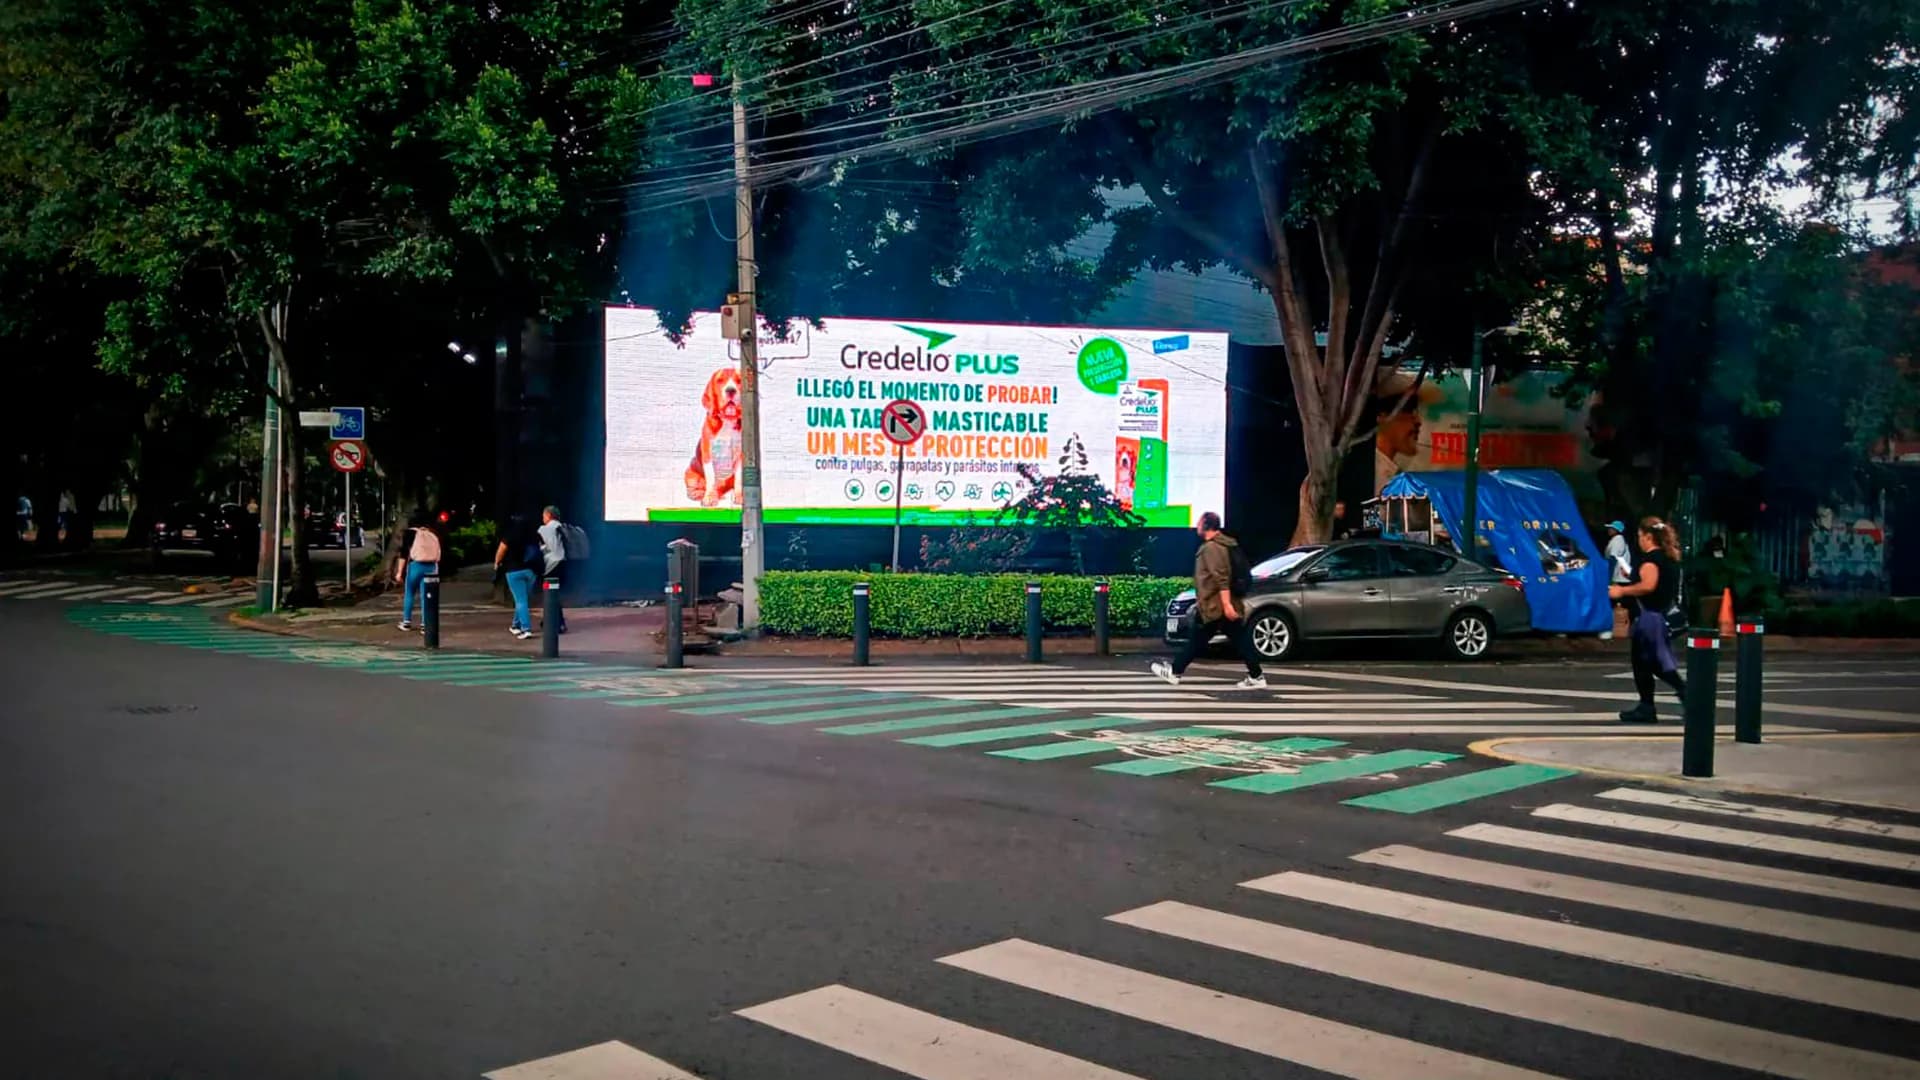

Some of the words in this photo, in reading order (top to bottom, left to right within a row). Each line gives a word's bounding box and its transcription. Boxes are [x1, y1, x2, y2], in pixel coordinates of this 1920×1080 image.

[841, 343, 950, 372] Credelio
[955, 354, 1019, 374] PLUS
[797, 375, 854, 399] ¡LLEGÓ
[859, 380, 876, 399] EL
[881, 381, 960, 402] MOMENTO
[964, 384, 983, 402] DE
[988, 385, 1057, 404] PROBAR!
[807, 406, 846, 428] UNA
[933, 410, 1048, 432] MASTICABLE
[807, 431, 836, 455] UN
[842, 432, 885, 456] MES
[922, 431, 1047, 459] PROTECCIÓN
[815, 456, 848, 470] contra
[851, 457, 888, 473] pulgas,
[944, 461, 951, 475] y
[953, 458, 998, 474] parásitos
